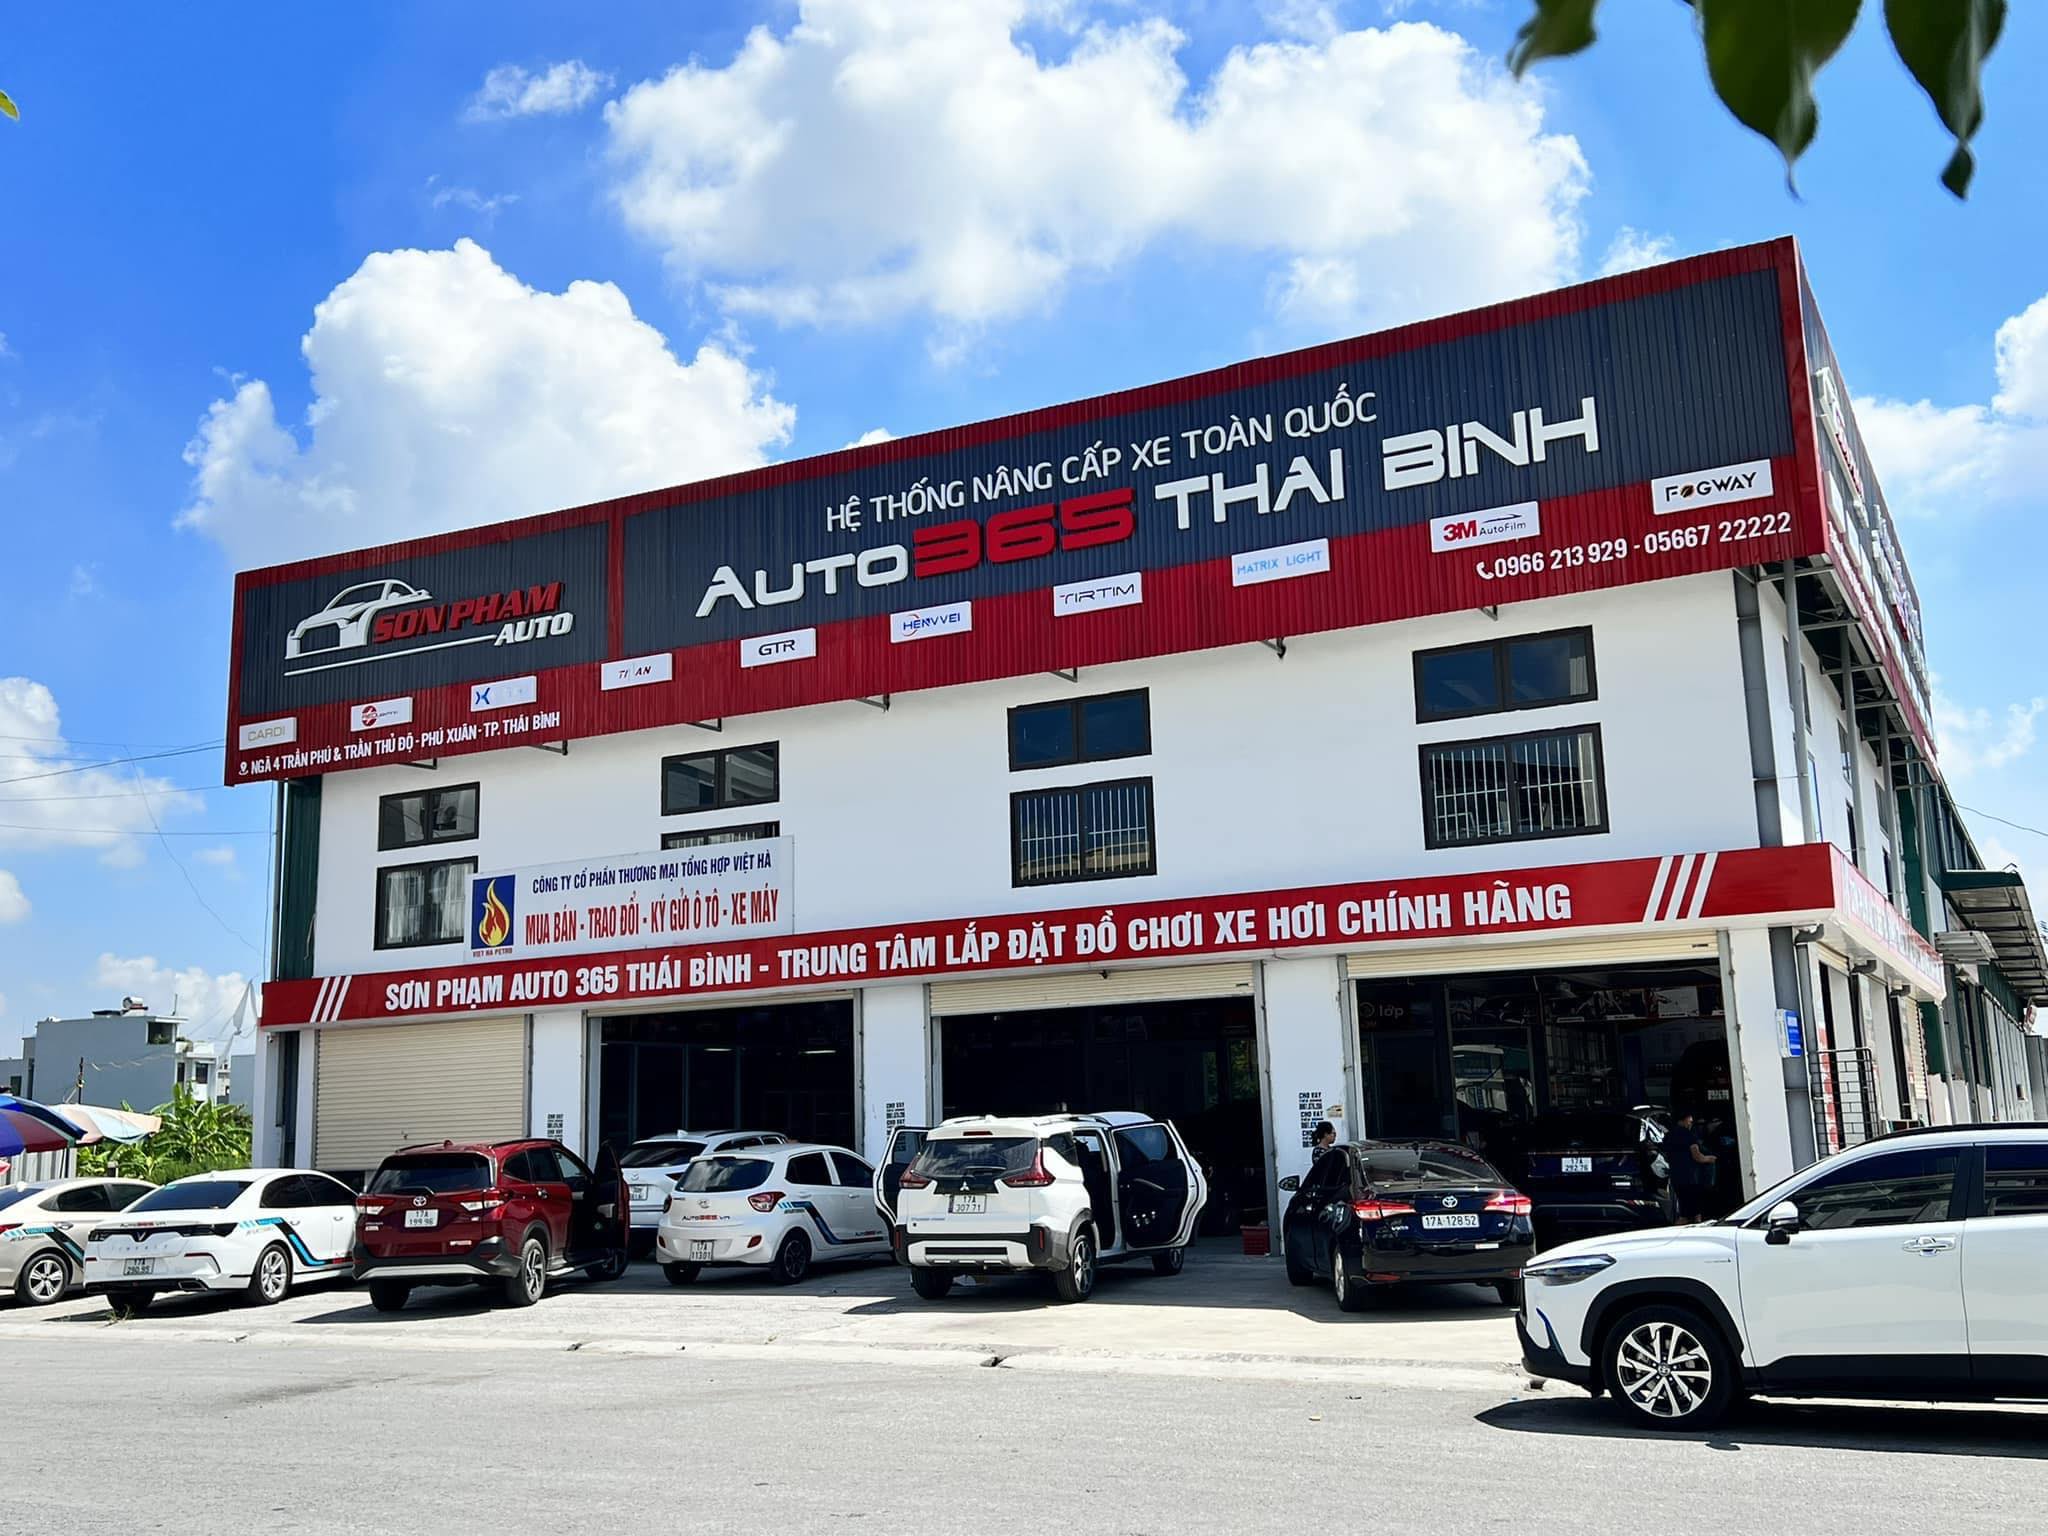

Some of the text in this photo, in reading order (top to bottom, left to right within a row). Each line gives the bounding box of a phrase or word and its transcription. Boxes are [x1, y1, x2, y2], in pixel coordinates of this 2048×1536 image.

[826, 383, 1378, 532] HỆ THỐNG NÂNG CẤP XE TOÀN QUỐC
[1153, 447, 1345, 530] THAI
[1382, 396, 1600, 491] BINH
[1443, 520, 1527, 541] 3M AutoFilm
[1493, 551, 1545, 578] 0966
[1550, 545, 1584, 570] 213
[1588, 538, 1627, 564] 929
[1644, 524, 1711, 554] 05667
[1718, 511, 1792, 542] 22222
[1237, 550, 1322, 576] MATRIX LIGHT
[1059, 583, 1135, 604] TIRTIM
[373, 602, 448, 643] SƠN
[494, 612, 574, 646] AUTO
[758, 639, 796, 656] GTR
[247, 726, 286, 741] CARDI
[273, 757, 280, 770] 4
[310, 745, 332, 765] PHÚ
[333, 746, 342, 761] &
[374, 733, 396, 755] THỦ
[398, 732, 414, 753] ĐỘ
[421, 727, 444, 748] PHÚ
[446, 723, 477, 744] XUÂN
[483, 721, 501, 738] TP.
[502, 714, 529, 735] THÁI
[533, 711, 560, 730] BÌNH
[532, 875, 558, 894] CÔNG
[561, 875, 571, 891] TY
[574, 867, 588, 889] CỔ
[618, 865, 656, 884] THƯƠNG
[659, 863, 679, 882] MẠI
[681, 854, 708, 877] TỔNG
[710, 855, 730, 877] HỢP
[733, 851, 755, 874] VIỆT
[757, 849, 771, 869] HÀ
[526, 913, 550, 946] MUA
[553, 904, 577, 943] BÁN
[588, 905, 616, 939] TRAO
[620, 890, 639, 936] ĐỔI
[651, 893, 666, 933] KÝ
[670, 887, 689, 931] GỬI
[694, 889, 702, 929] Ô
[705, 887, 719, 928] TÔ
[731, 892, 747, 926] XE
[751, 882, 779, 924] MÁY
[385, 979, 431, 1011] SƠN
[436, 974, 503, 1009] PHẠM
[509, 969, 569, 1001] AUTO
[575, 965, 619, 996] 365
[626, 955, 682, 992] THÁI
[689, 952, 752, 987] BÌNH
[777, 943, 868, 979] TRUNG
[875, 933, 937, 971] TÂM
[945, 921, 1000, 965] LẮP
[1007, 921, 1066, 964] ĐẶT
[1075, 909, 1117, 955] ĐỒ
[1127, 911, 1203, 951] CHƠI
[1213, 909, 1257, 944] XE
[1268, 901, 1326, 941] HƠI
[1337, 890, 1452, 935] CHÍNH
[1463, 879, 1573, 926] HÃNG
[962, 1195, 976, 1203] 17A
